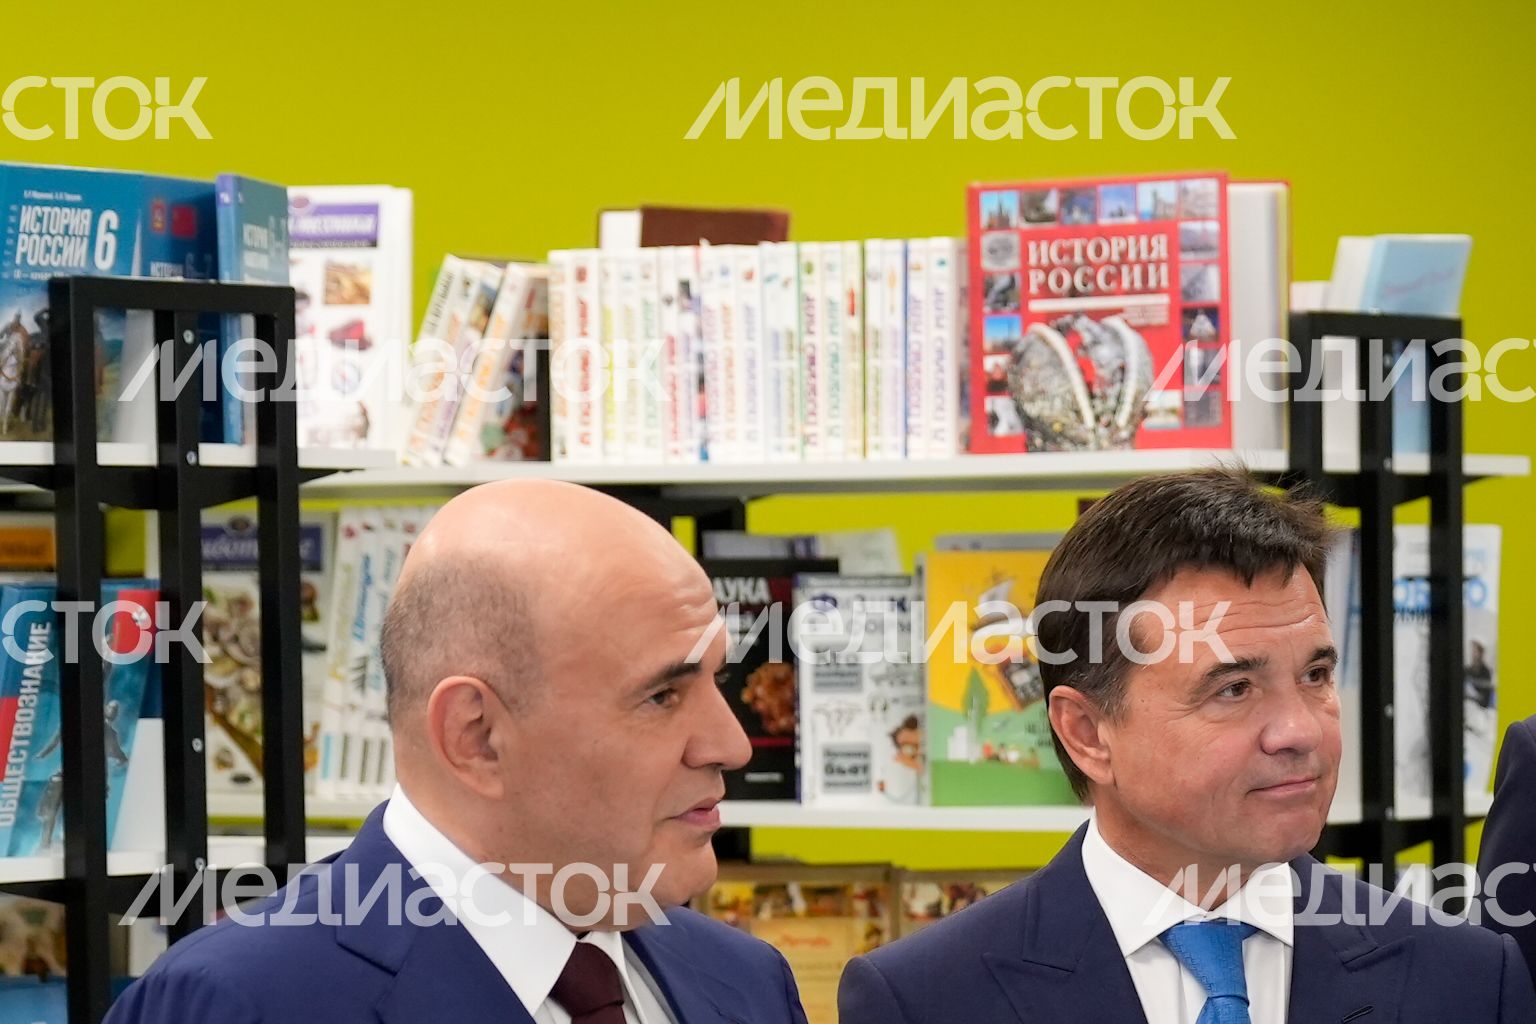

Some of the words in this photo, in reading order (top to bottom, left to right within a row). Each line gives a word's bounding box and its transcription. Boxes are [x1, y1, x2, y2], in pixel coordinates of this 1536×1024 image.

[15, 232, 89, 267] РОССИИ
[19, 205, 92, 236] ИСТОРИЯ
[94, 209, 119, 271] 6
[1027, 233, 1169, 267] ИСТОРИЯ
[1028, 262, 1170, 295] РОССИИ
